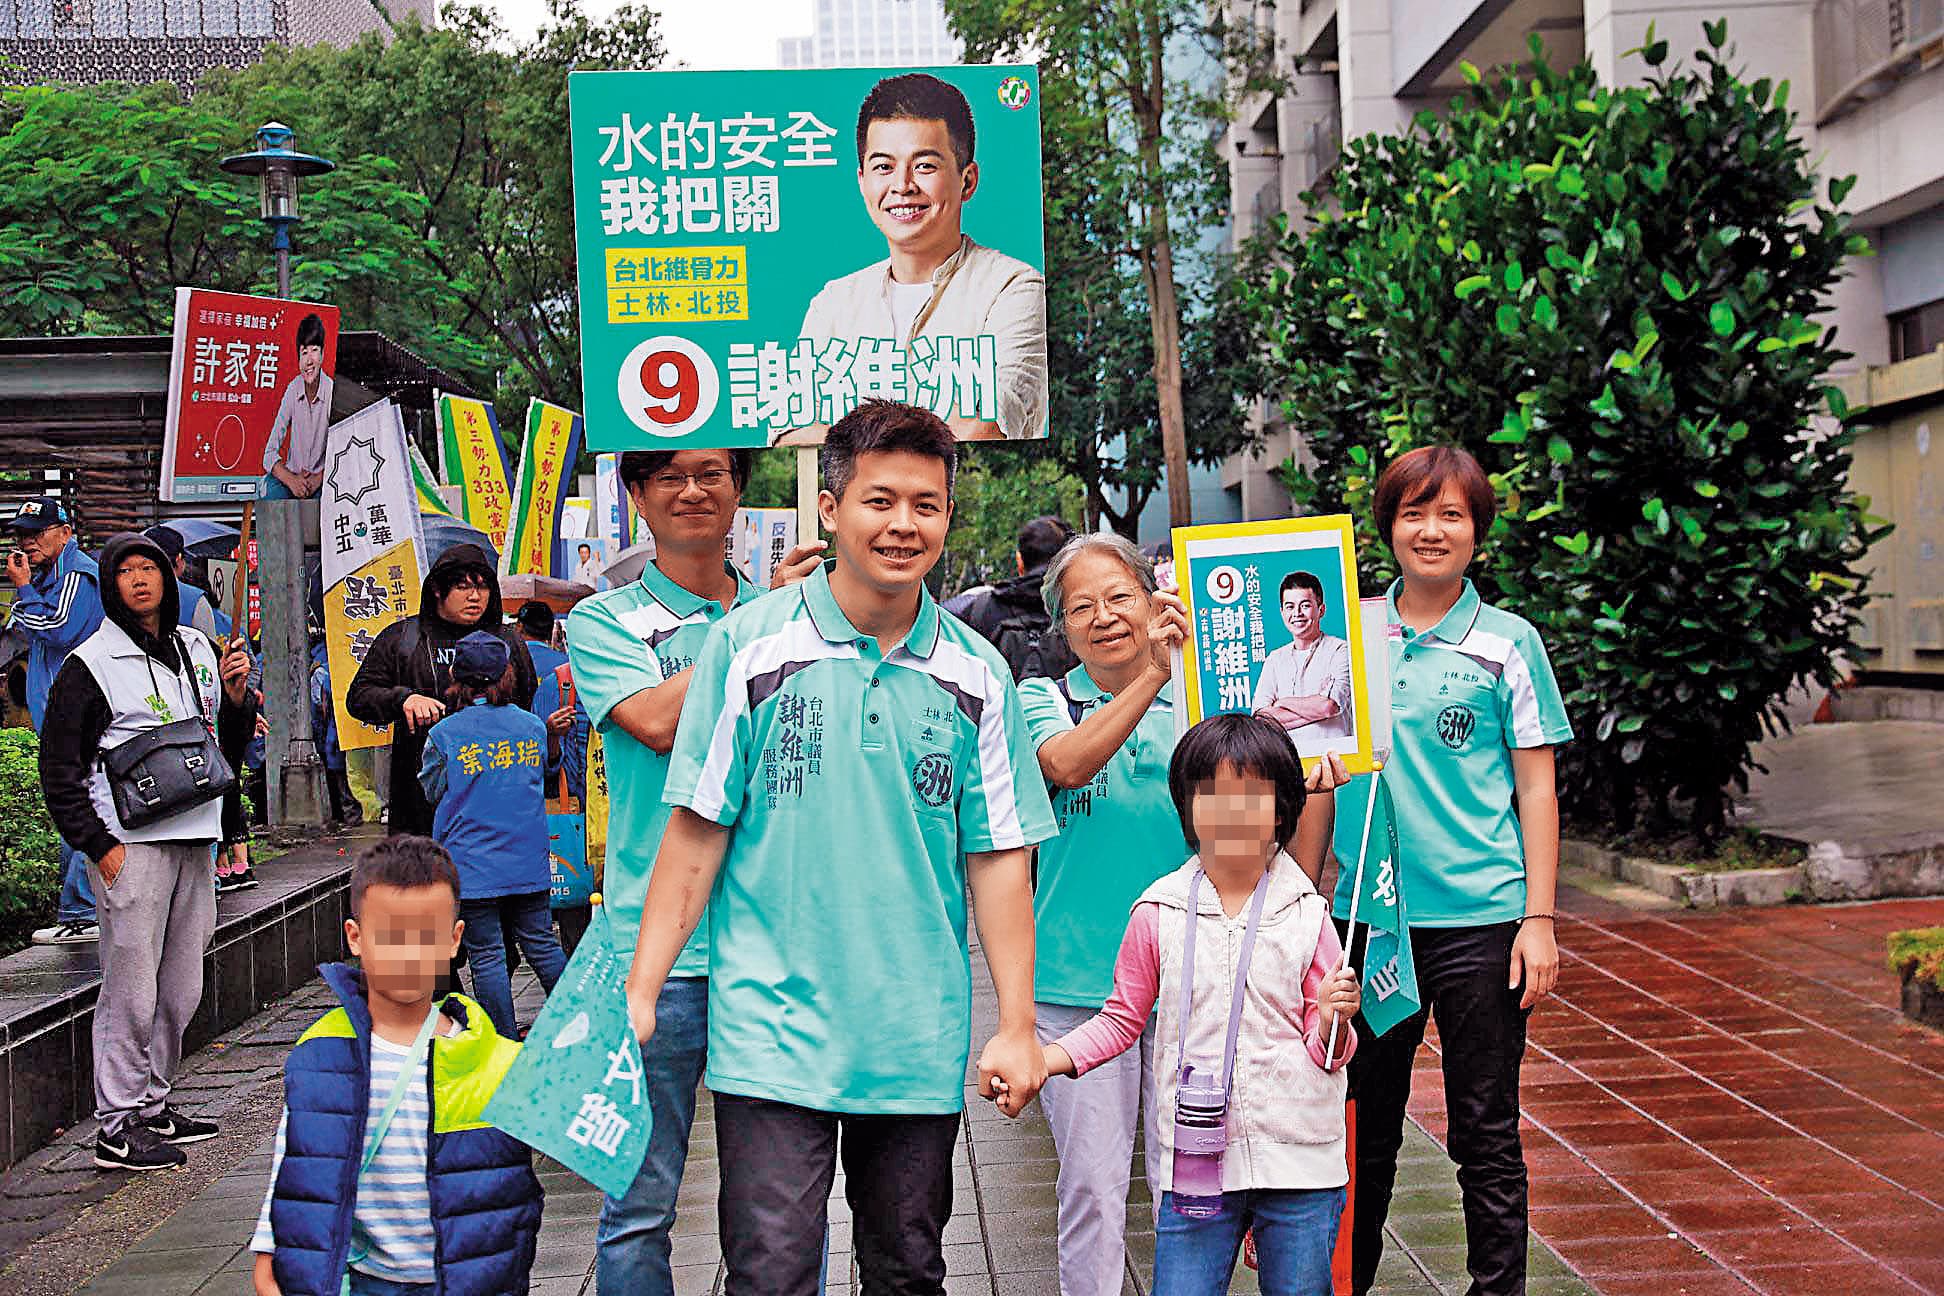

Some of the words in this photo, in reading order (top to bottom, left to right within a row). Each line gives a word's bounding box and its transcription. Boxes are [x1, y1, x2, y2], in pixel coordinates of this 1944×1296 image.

[598, 111, 838, 172] 水的安全
[600, 175, 780, 236] 我把關
[613, 255, 738, 283] 台北維骨力
[193, 336, 280, 389] 許家蓓
[639, 350, 700, 425] 9
[728, 335, 998, 429] 謝維洲
[367, 504, 393, 545] 萬華
[1216, 572, 1234, 599] 9
[1244, 564, 1266, 663] 水的安全我把關
[1210, 605, 1252, 711] 謝維洲
[456, 739, 541, 776] 葉海瑞
[779, 693, 807, 799] 謝維洲
[807, 697, 823, 775] 台北市議員
[763, 748, 778, 810] 服務團隊
